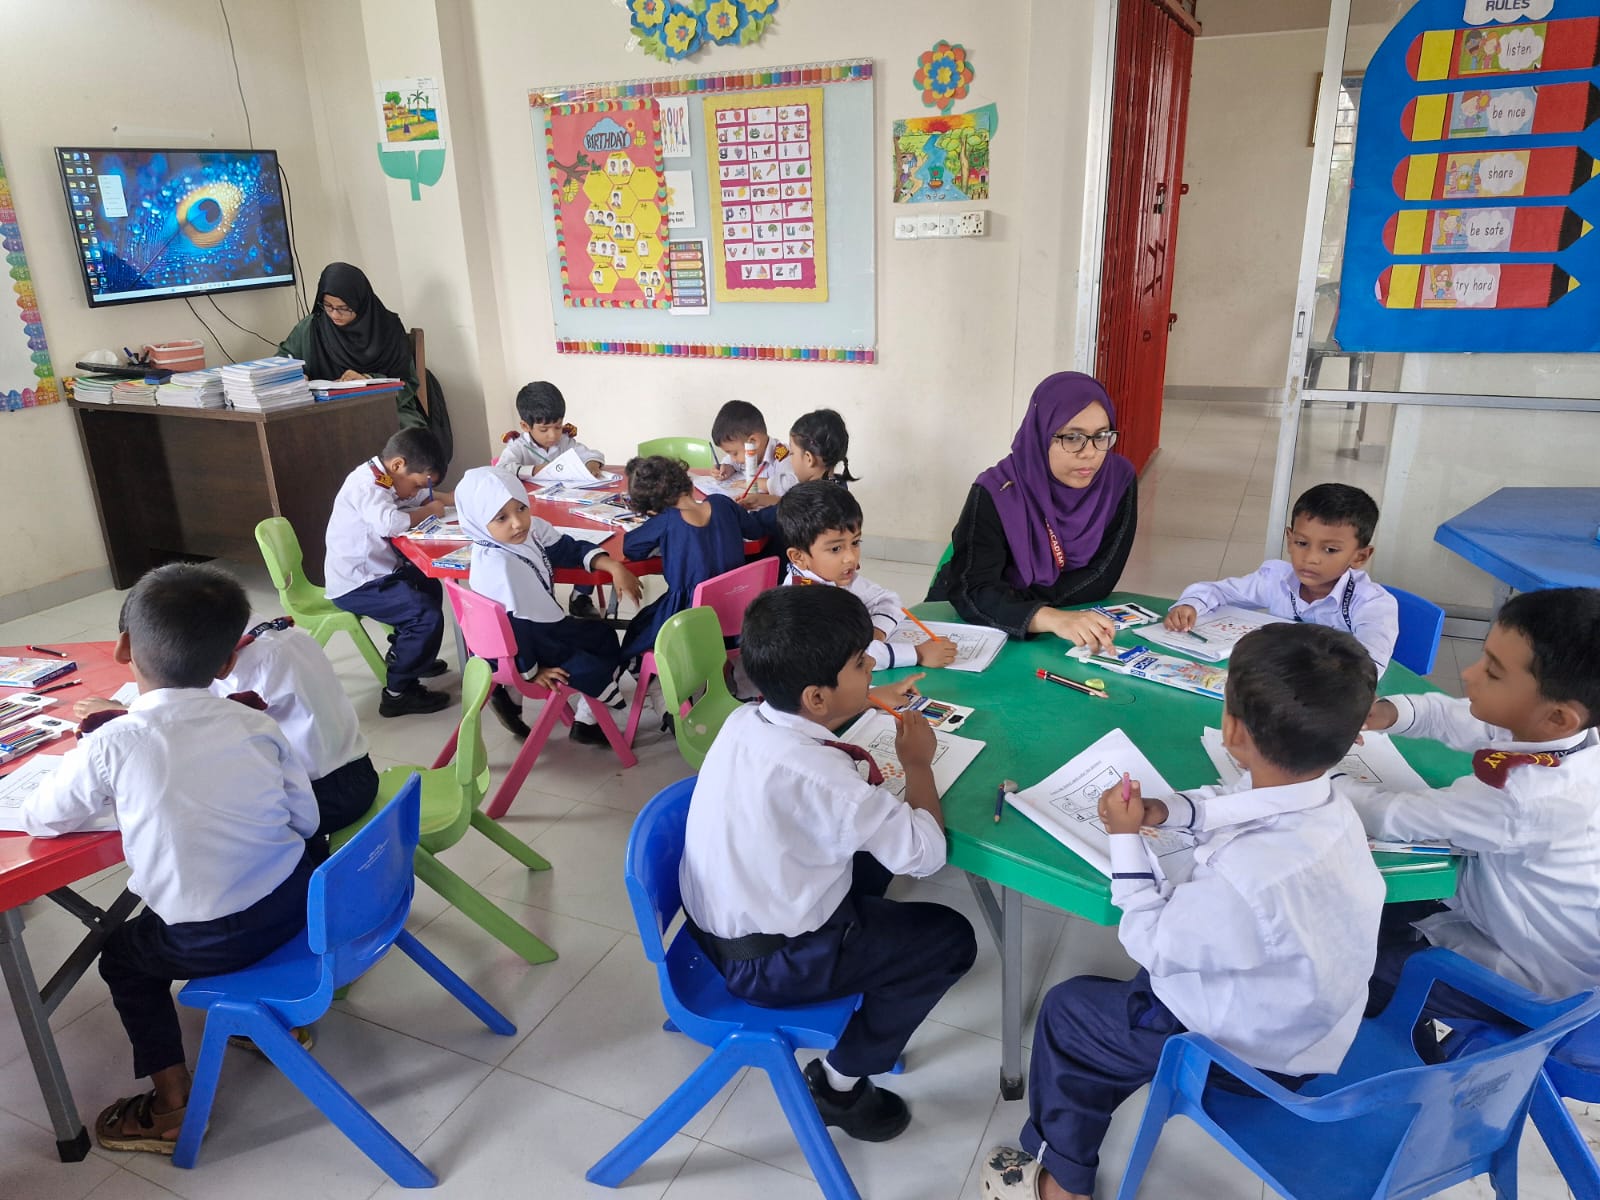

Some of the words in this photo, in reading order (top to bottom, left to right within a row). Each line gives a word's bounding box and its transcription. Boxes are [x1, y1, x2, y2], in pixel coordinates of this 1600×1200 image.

[1485, 0, 1530, 11] RULES
[1506, 42, 1531, 56] listen
[661, 106, 684, 129] ROUP
[1492, 105, 1503, 119] be
[1507, 108, 1526, 118] nice
[586, 130, 628, 150] BIRTHDAY
[751, 147, 758, 159] h
[752, 166, 762, 180] k
[1488, 165, 1514, 180] share
[723, 188, 735, 197] m
[725, 207, 735, 221] p
[757, 225, 764, 239] t
[786, 225, 796, 236] u
[1470, 222, 1481, 236] be
[1484, 221, 1505, 236] safe
[744, 266, 753, 279] y
[1455, 281, 1470, 297] try
[1472, 277, 1494, 291] hard
